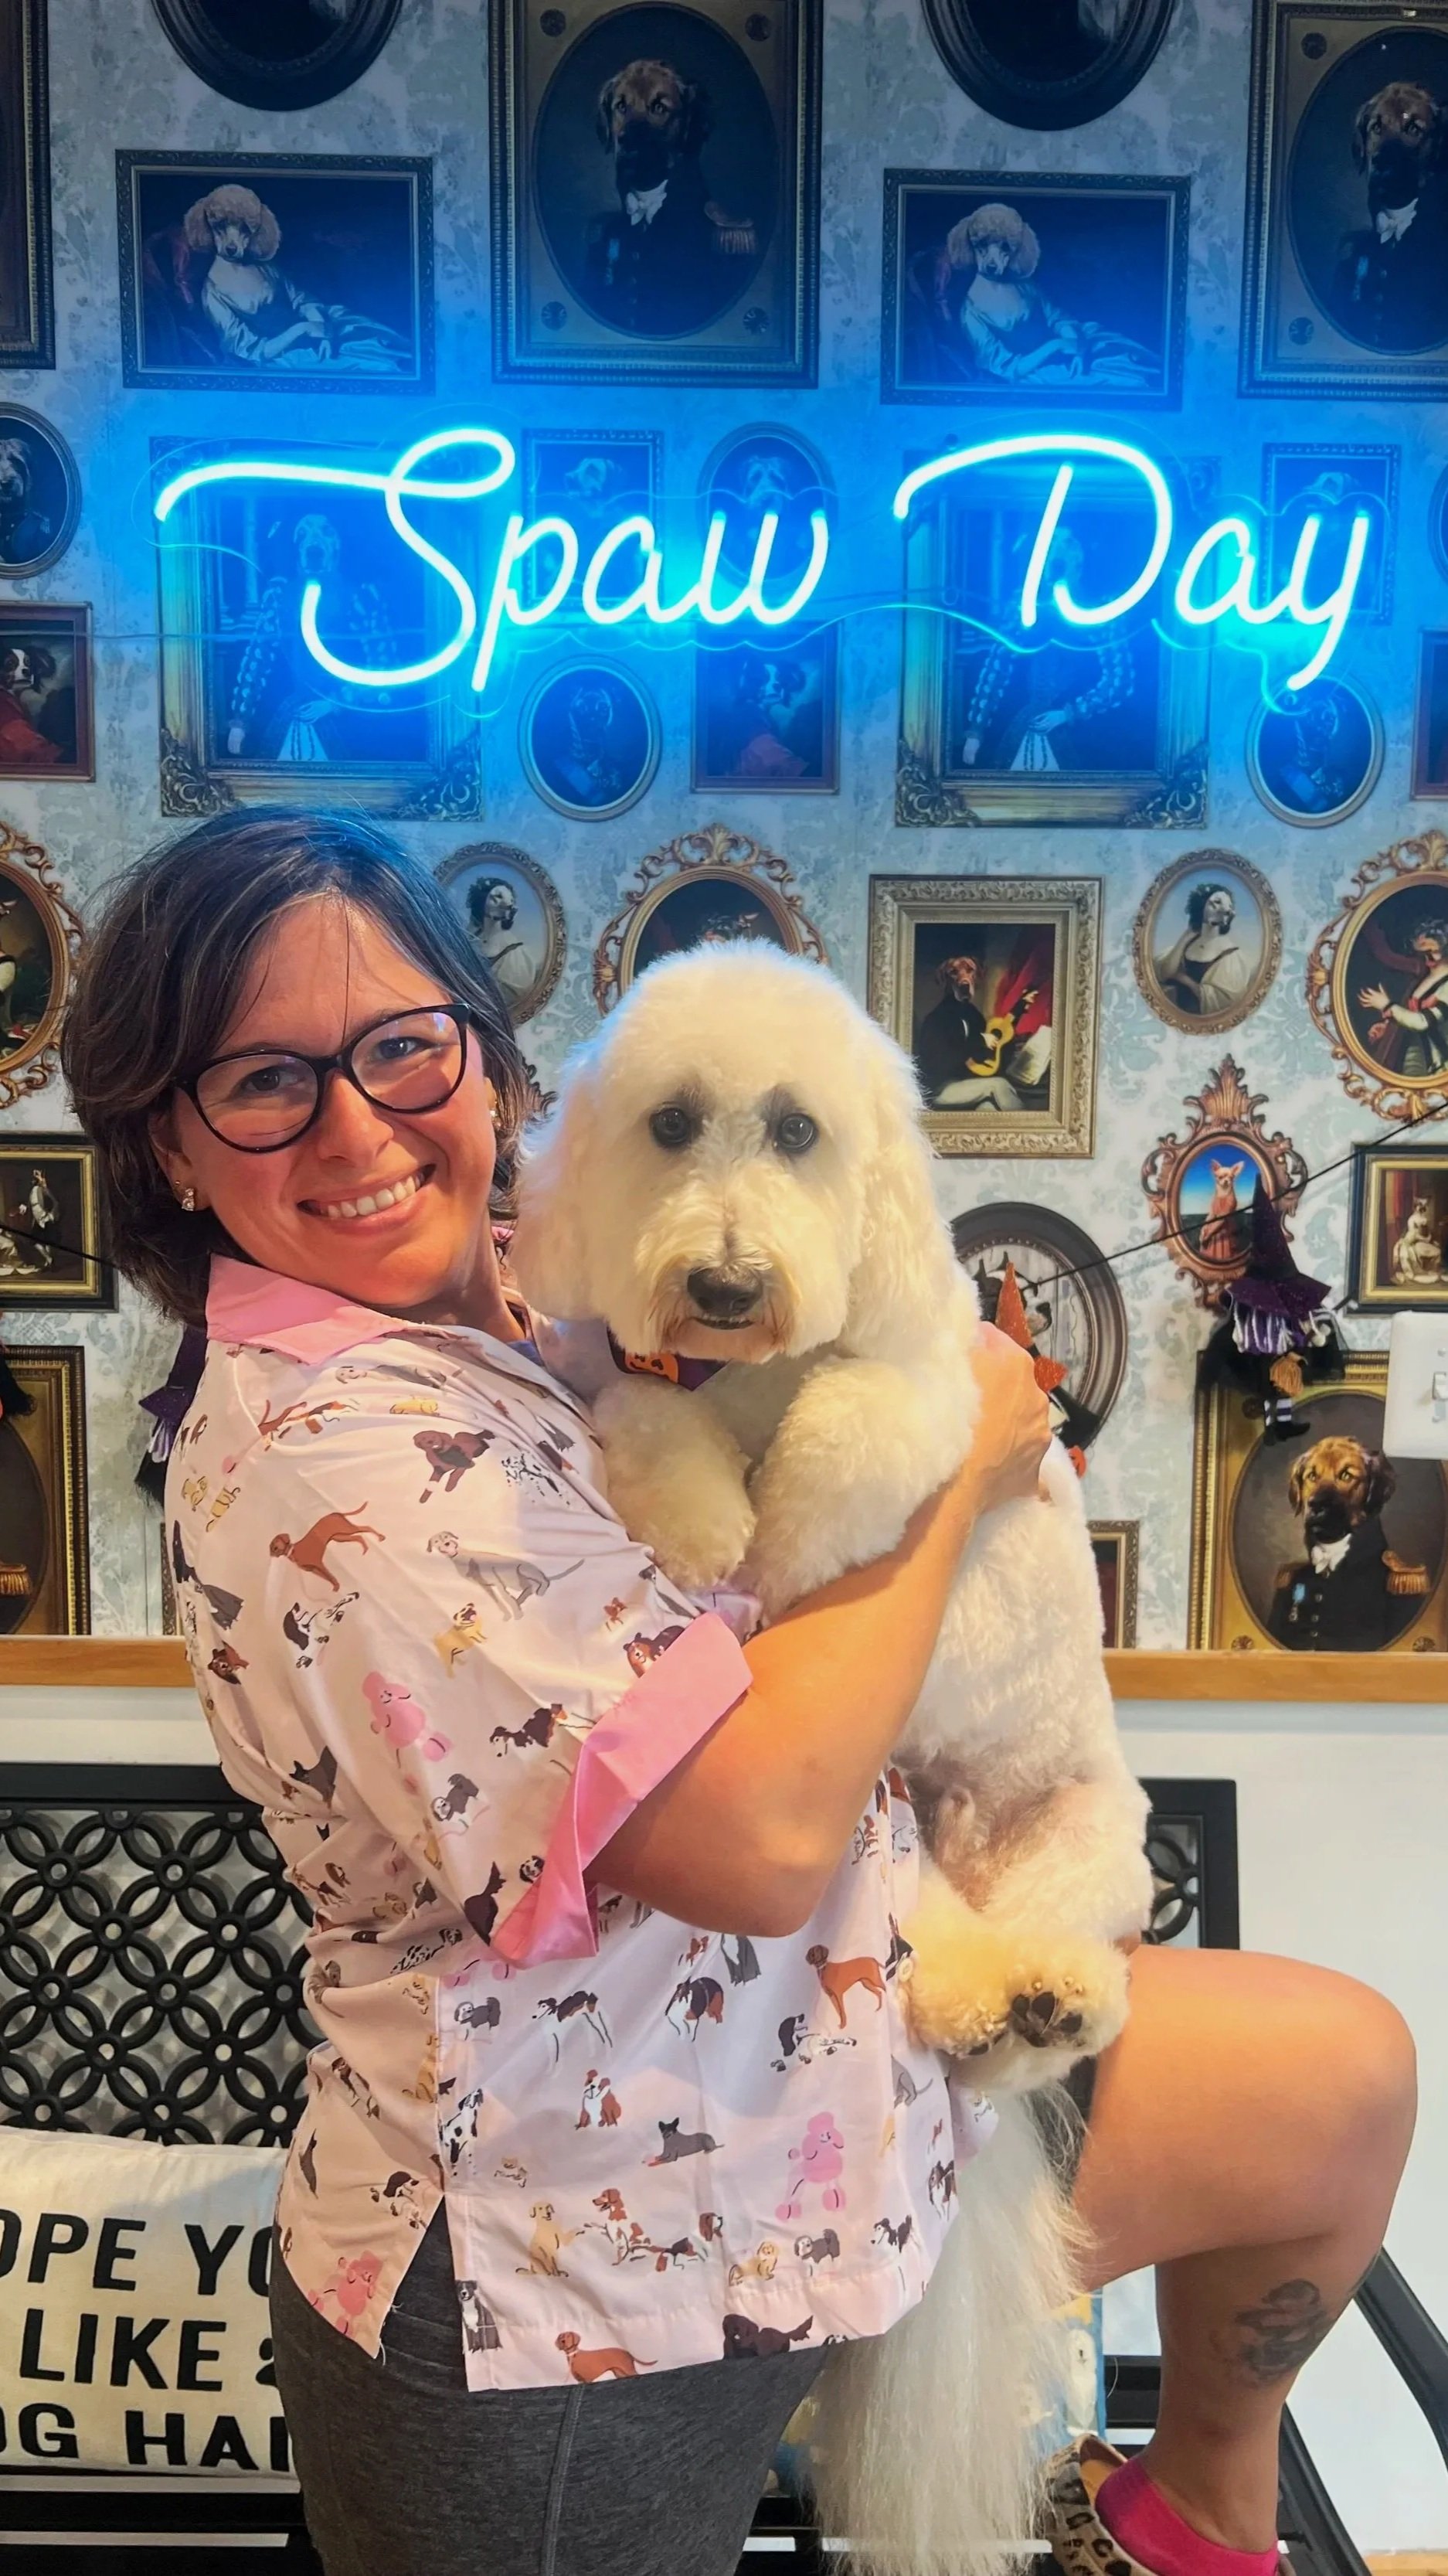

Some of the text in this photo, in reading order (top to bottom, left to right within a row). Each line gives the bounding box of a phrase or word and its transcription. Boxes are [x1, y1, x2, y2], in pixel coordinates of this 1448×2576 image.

[153, 428, 1369, 691] Spaw Day
[19, 2308, 227, 2392] LIKE
[0, 2402, 80, 2459] G
